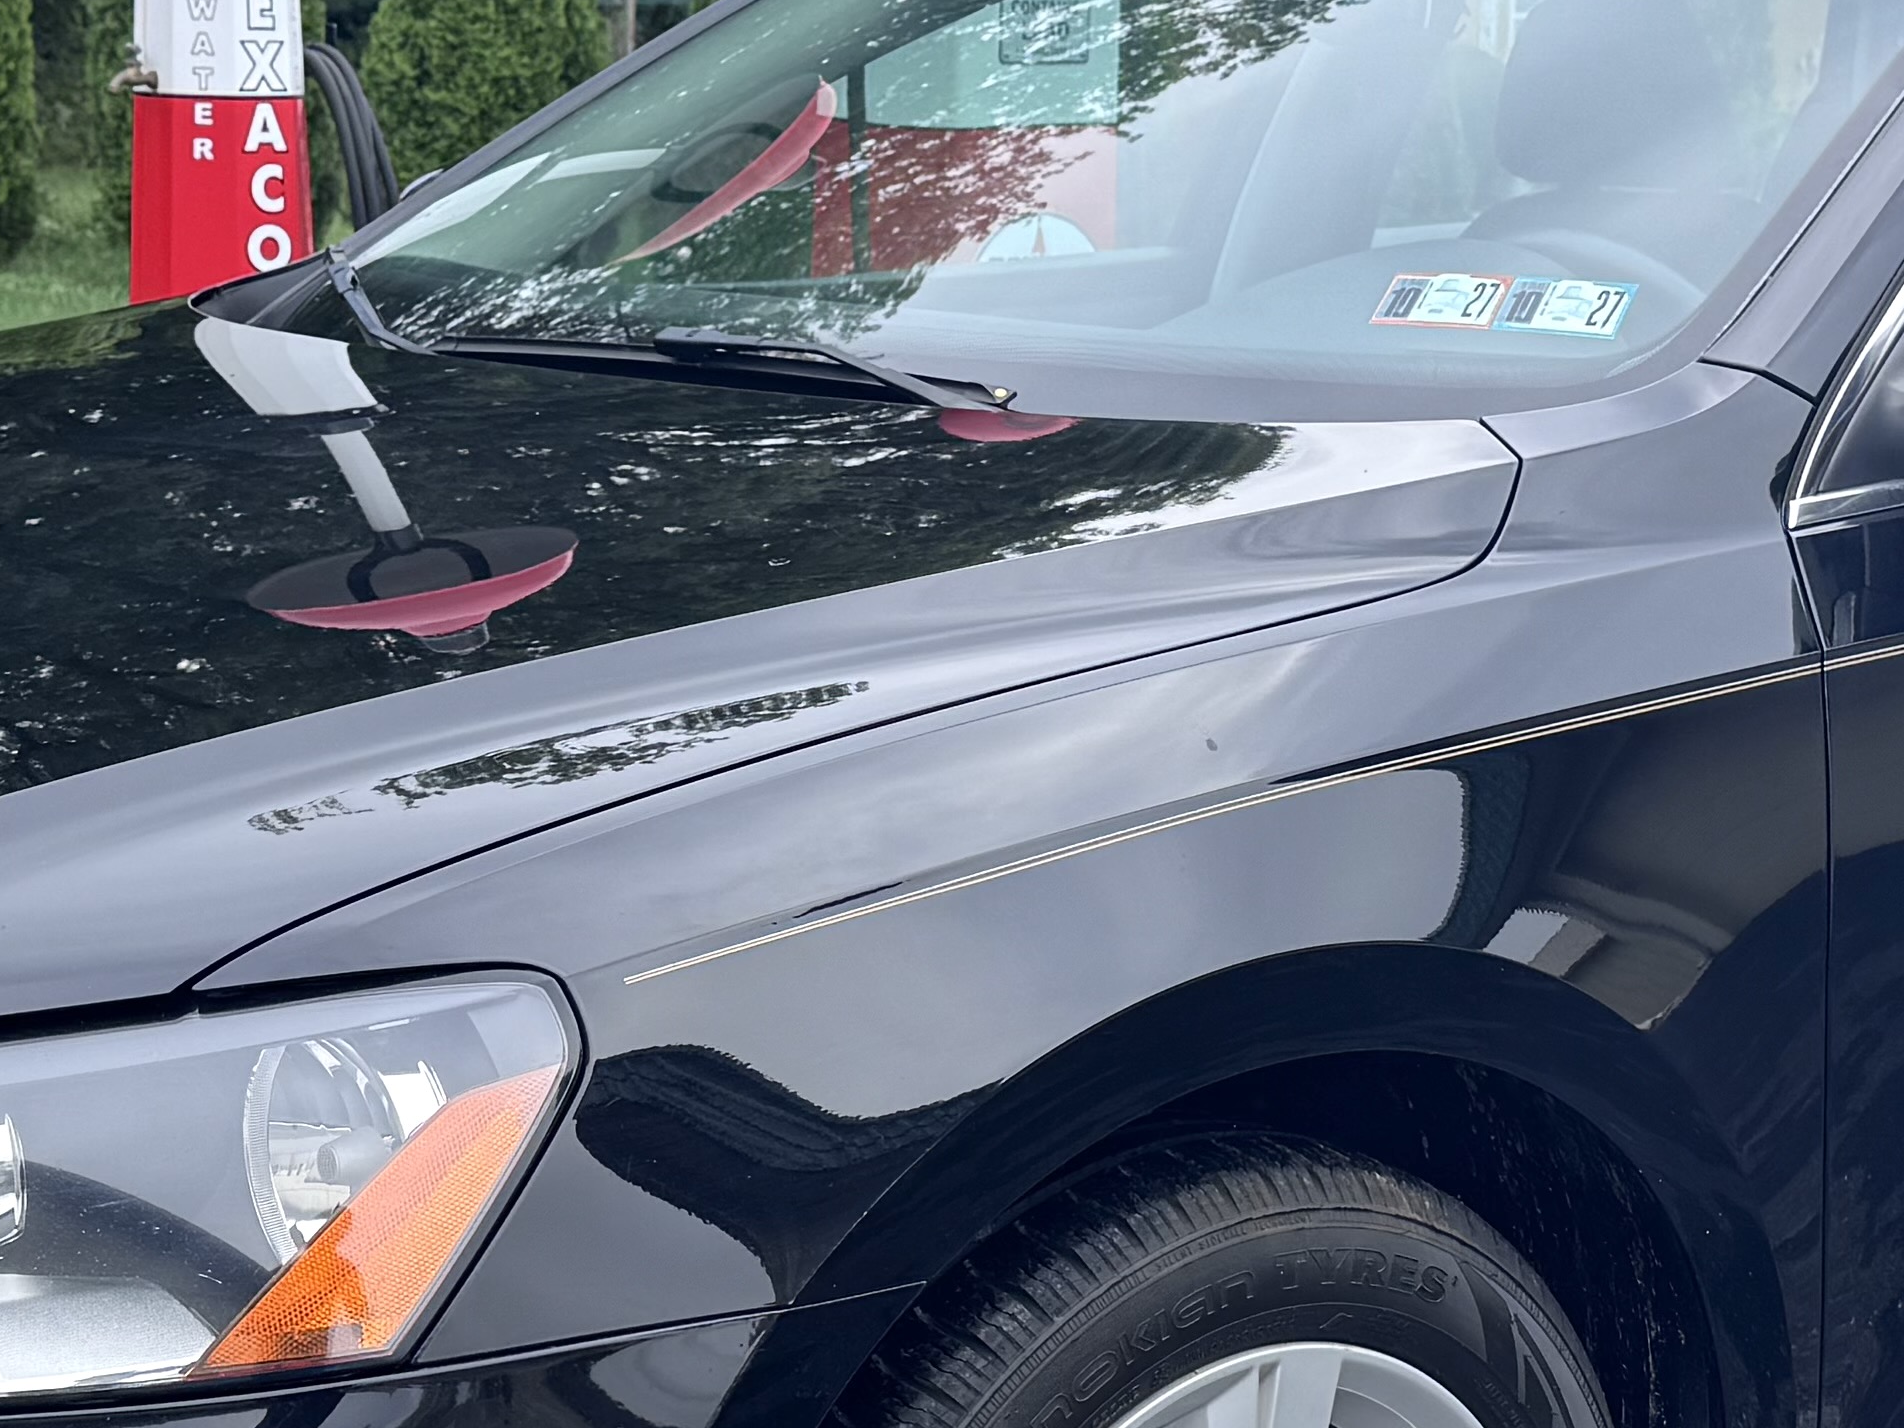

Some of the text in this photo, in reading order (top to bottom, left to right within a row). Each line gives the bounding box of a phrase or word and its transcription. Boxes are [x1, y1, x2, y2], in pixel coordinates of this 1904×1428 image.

[1384, 287, 1422, 319] 10
[1461, 282, 1501, 322] 27
[1505, 290, 1545, 325] 10
[1584, 290, 1627, 330] 27
[1275, 1247, 1448, 1304] TYRES
